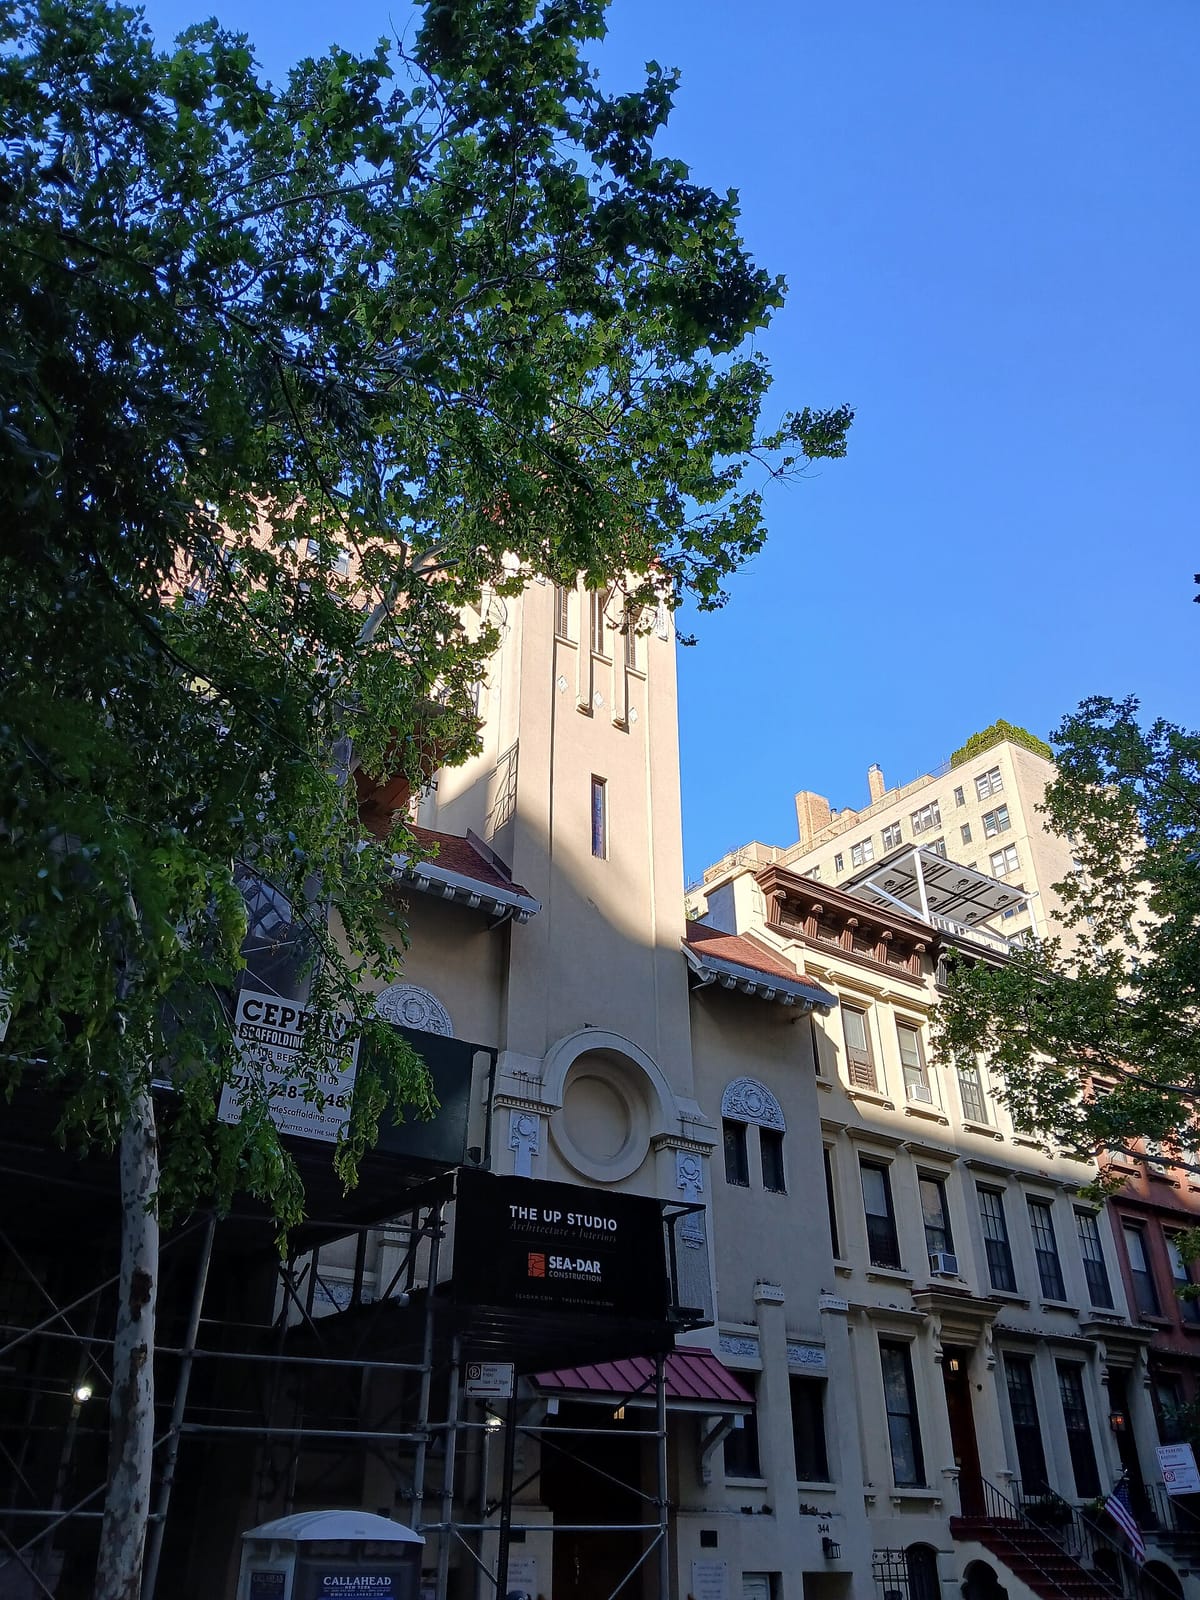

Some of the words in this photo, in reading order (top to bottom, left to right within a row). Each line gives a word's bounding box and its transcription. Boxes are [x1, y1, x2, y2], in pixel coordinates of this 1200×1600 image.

[241, 1025, 304, 1049] SCAFFOLDIN
[509, 1205, 538, 1221] THE
[543, 1209, 562, 1224] UP
[567, 1212, 618, 1232] STUDIO
[548, 1255, 601, 1274] SEA-DAR
[548, 1270, 602, 1283] CONSTRUCTION
[817, 1523, 830, 1534] 344
[323, 1576, 392, 1586] CALLAHEAD
